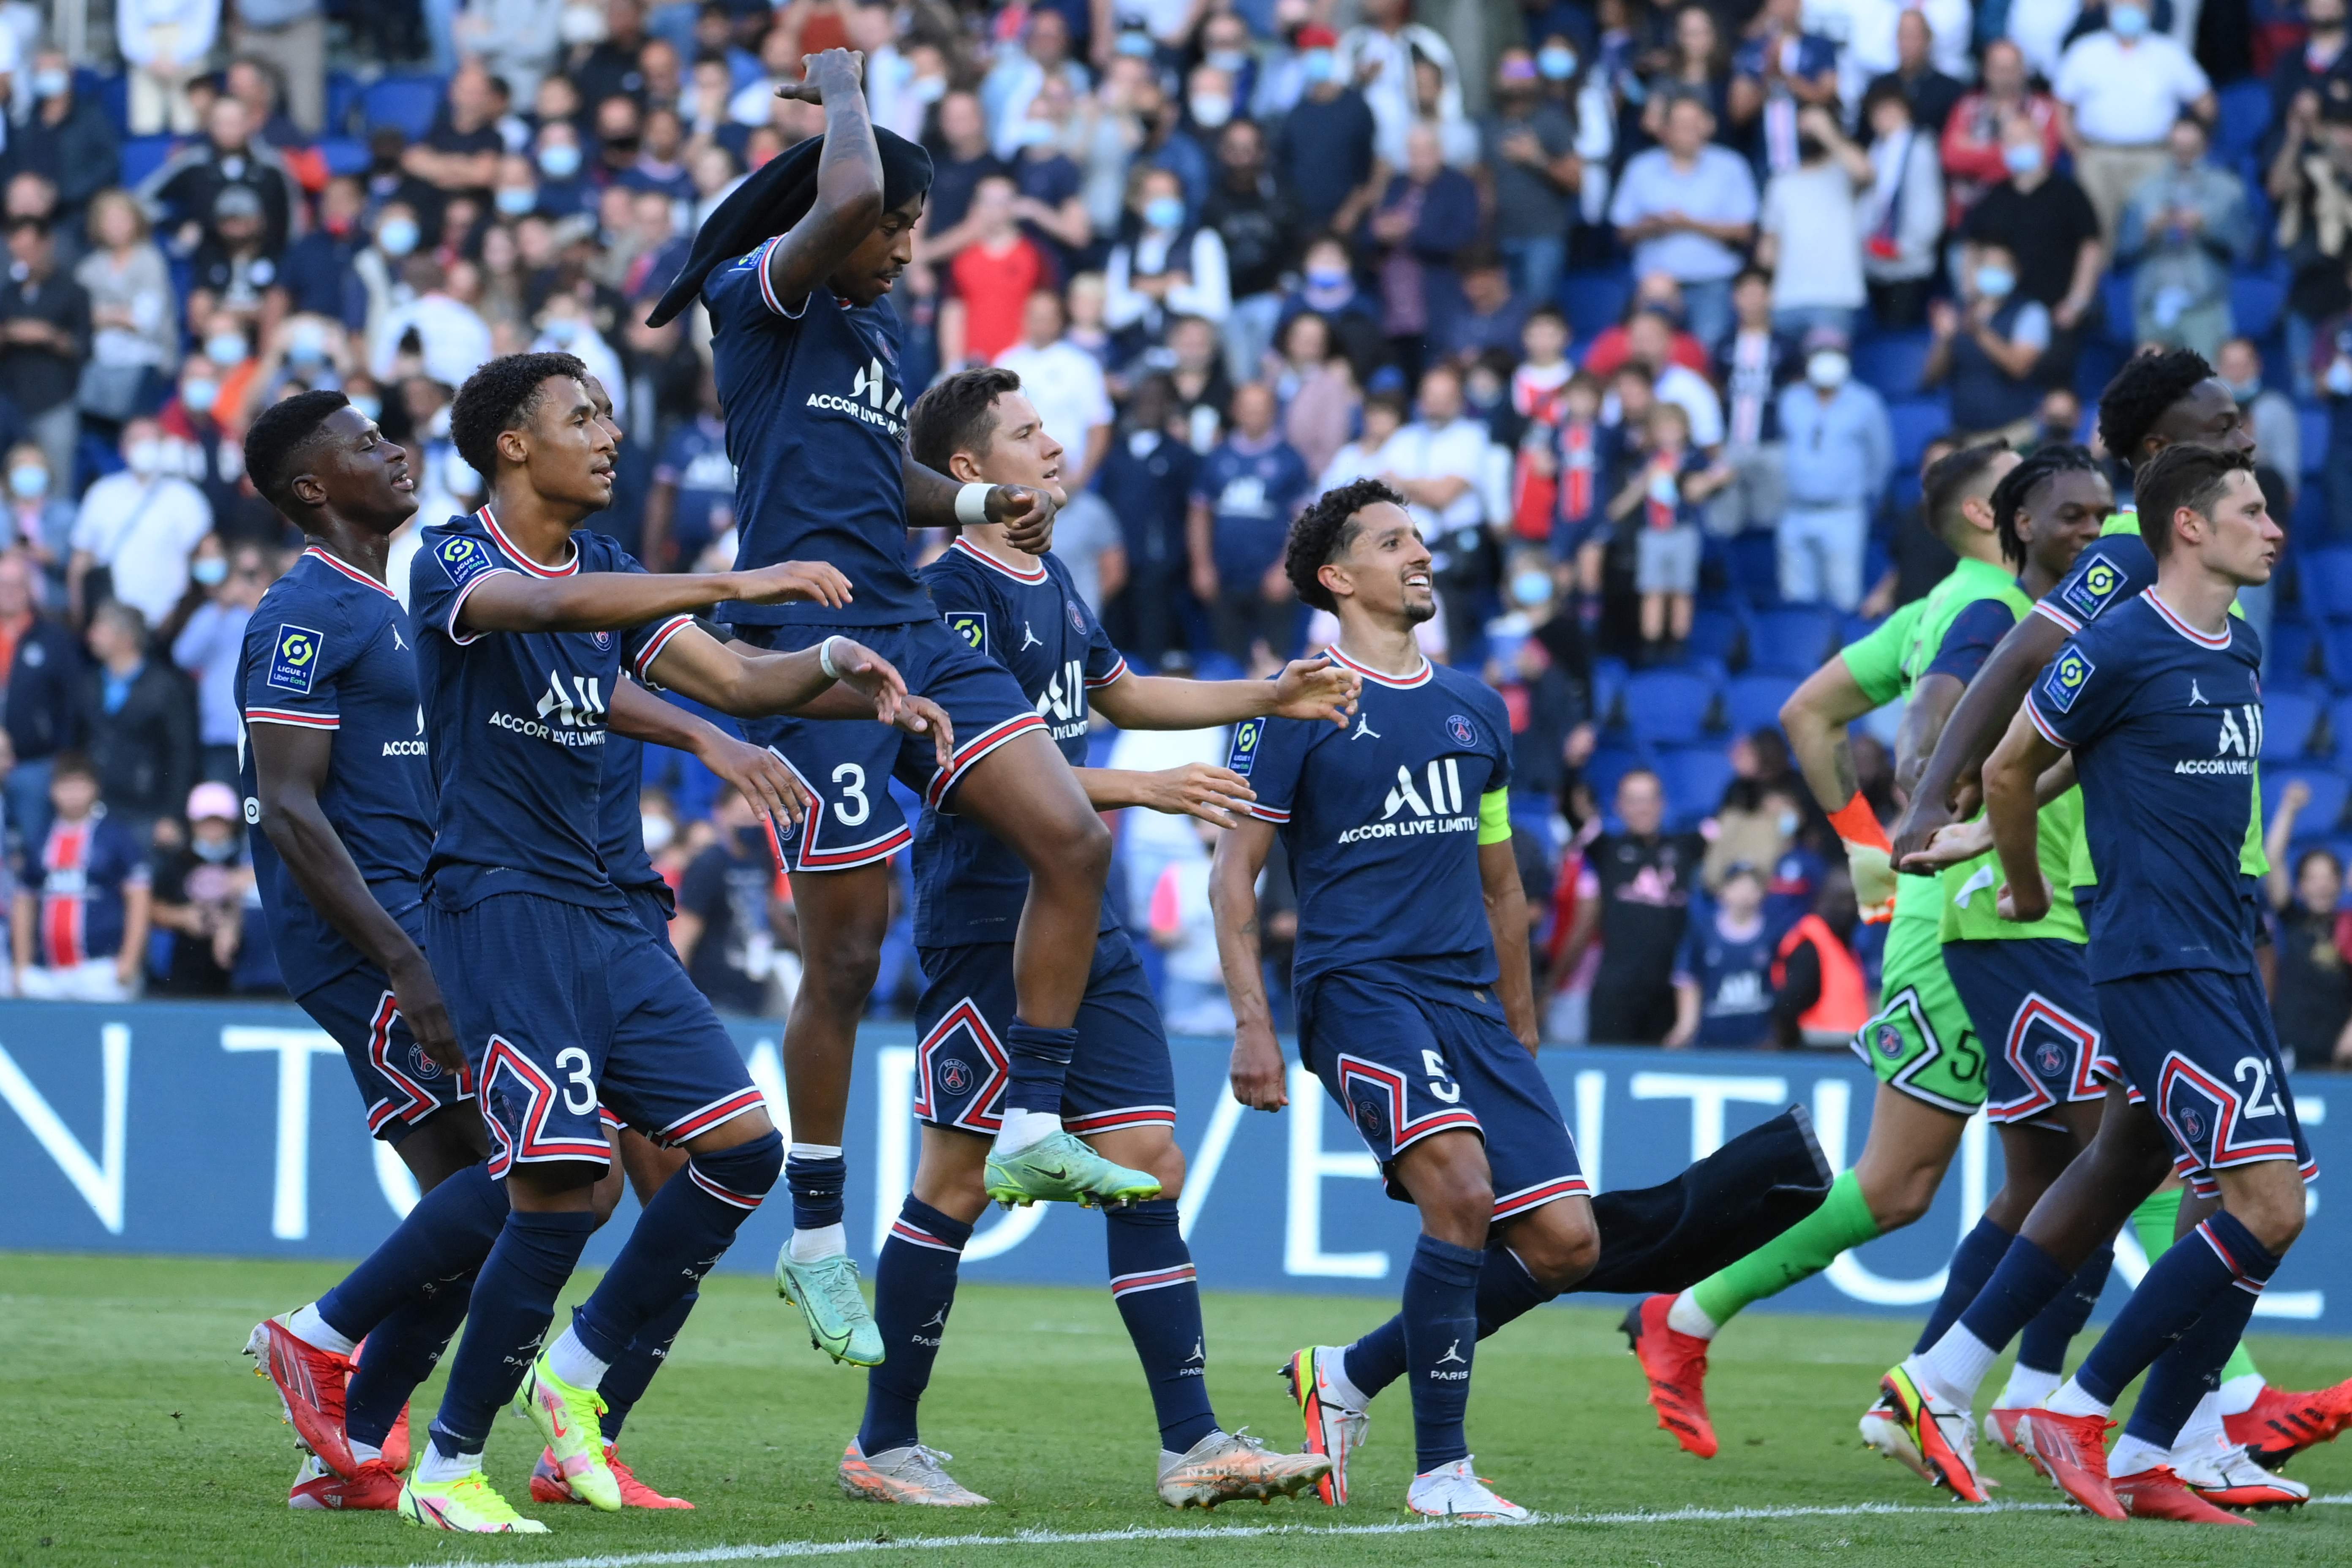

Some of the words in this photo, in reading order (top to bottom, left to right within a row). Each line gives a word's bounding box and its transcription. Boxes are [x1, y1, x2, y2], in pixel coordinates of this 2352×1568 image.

[806, 393, 859, 417] ACCOR
[861, 406, 886, 426] LIVE
[454, 556, 474, 575] LIGUE
[457, 568, 468, 582] Uber
[468, 560, 485, 570] Eats
[278, 665, 301, 676] LIGUE
[273, 673, 289, 682] Uber
[290, 677, 306, 686] Eats
[488, 710, 549, 739] ACCOR
[552, 729, 575, 746] LIVE
[1066, 720, 1089, 738] LIMIT
[382, 741, 427, 756] ACCOR
[2175, 760, 2226, 774] ACCOR
[2226, 760, 2248, 775] LIVE
[832, 763, 870, 826] 3
[1338, 823, 1397, 844] ACCOR
[1399, 819, 1436, 836] LIVE
[410, 1044, 422, 1057] PAR
[1950, 1029, 1987, 1087] 5
[944, 1061, 967, 1071] PARIS
[555, 1047, 598, 1116] 3
[1421, 1049, 1460, 1104] 5
[682, 1268, 703, 1281] PA
[503, 1356, 533, 1367] PAR
[651, 1348, 666, 1359] PA
[1430, 1370, 1469, 1380] PARIS
